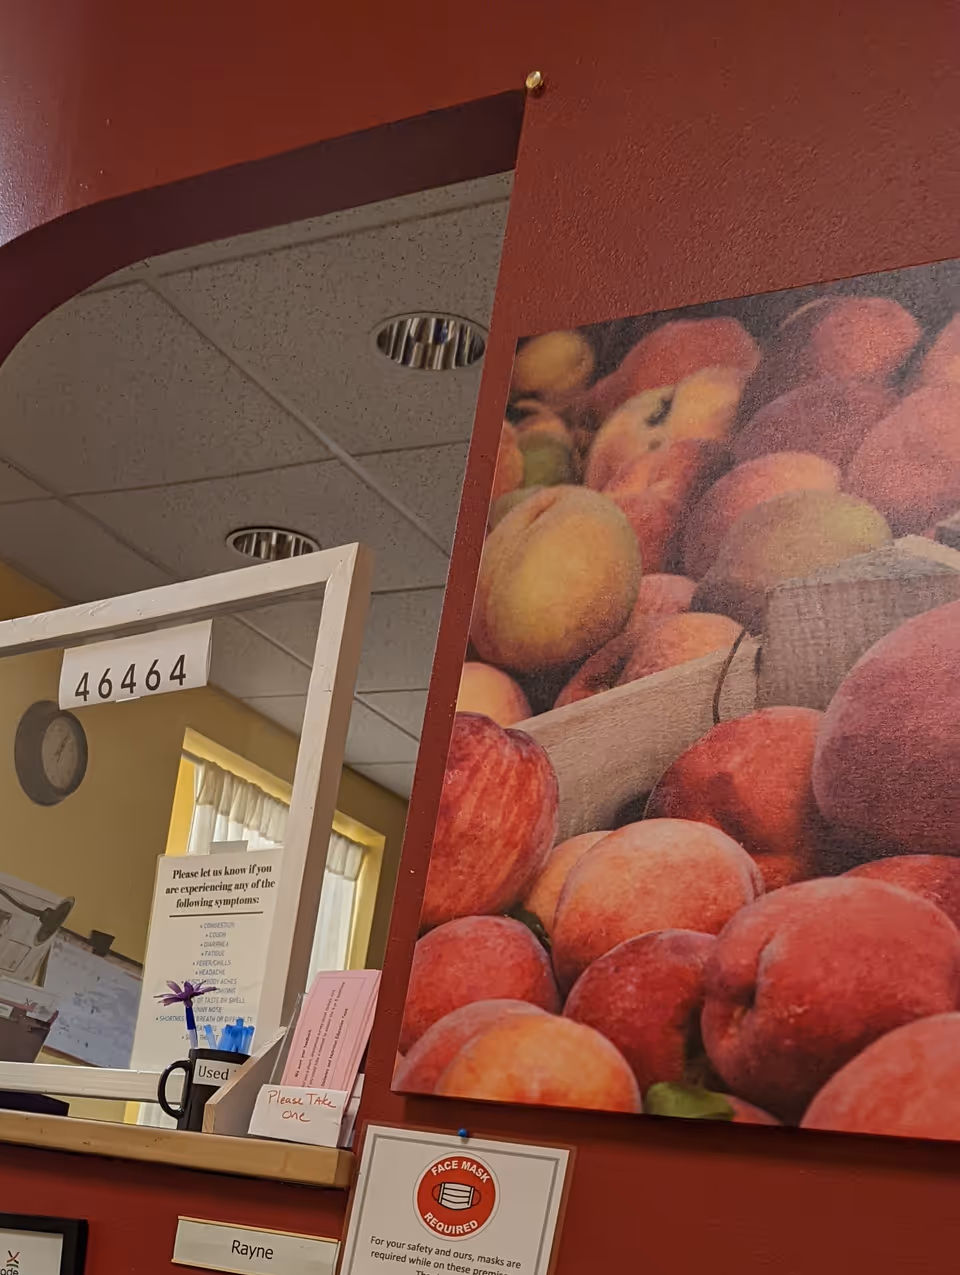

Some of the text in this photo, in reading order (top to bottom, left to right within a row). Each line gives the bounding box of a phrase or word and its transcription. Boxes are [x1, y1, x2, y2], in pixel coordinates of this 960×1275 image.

[75, 654, 186, 701] 46464
[172, 869, 199, 879] Please
[200, 868, 210, 877] let
[224, 866, 246, 875] know
[249, 864, 257, 874] if
[256, 865, 272, 876] you
[165, 879, 275, 895] are experiencing any of the
[176, 896, 260, 908] following symptoms:
[199, 1066, 229, 1080] Used
[268, 1090, 303, 1105] Please
[431, 1160, 490, 1183] FACE MASK
[424, 1212, 478, 1234] REQUIRED
[232, 1240, 273, 1260] Rayne
[370, 1236, 522, 1269] For your safety and ours, masks are
[371, 1250, 406, 1264] required
[408, 1255, 431, 1267] while
[434, 1262, 444, 1270] on
[446, 1262, 470, 1274] these
